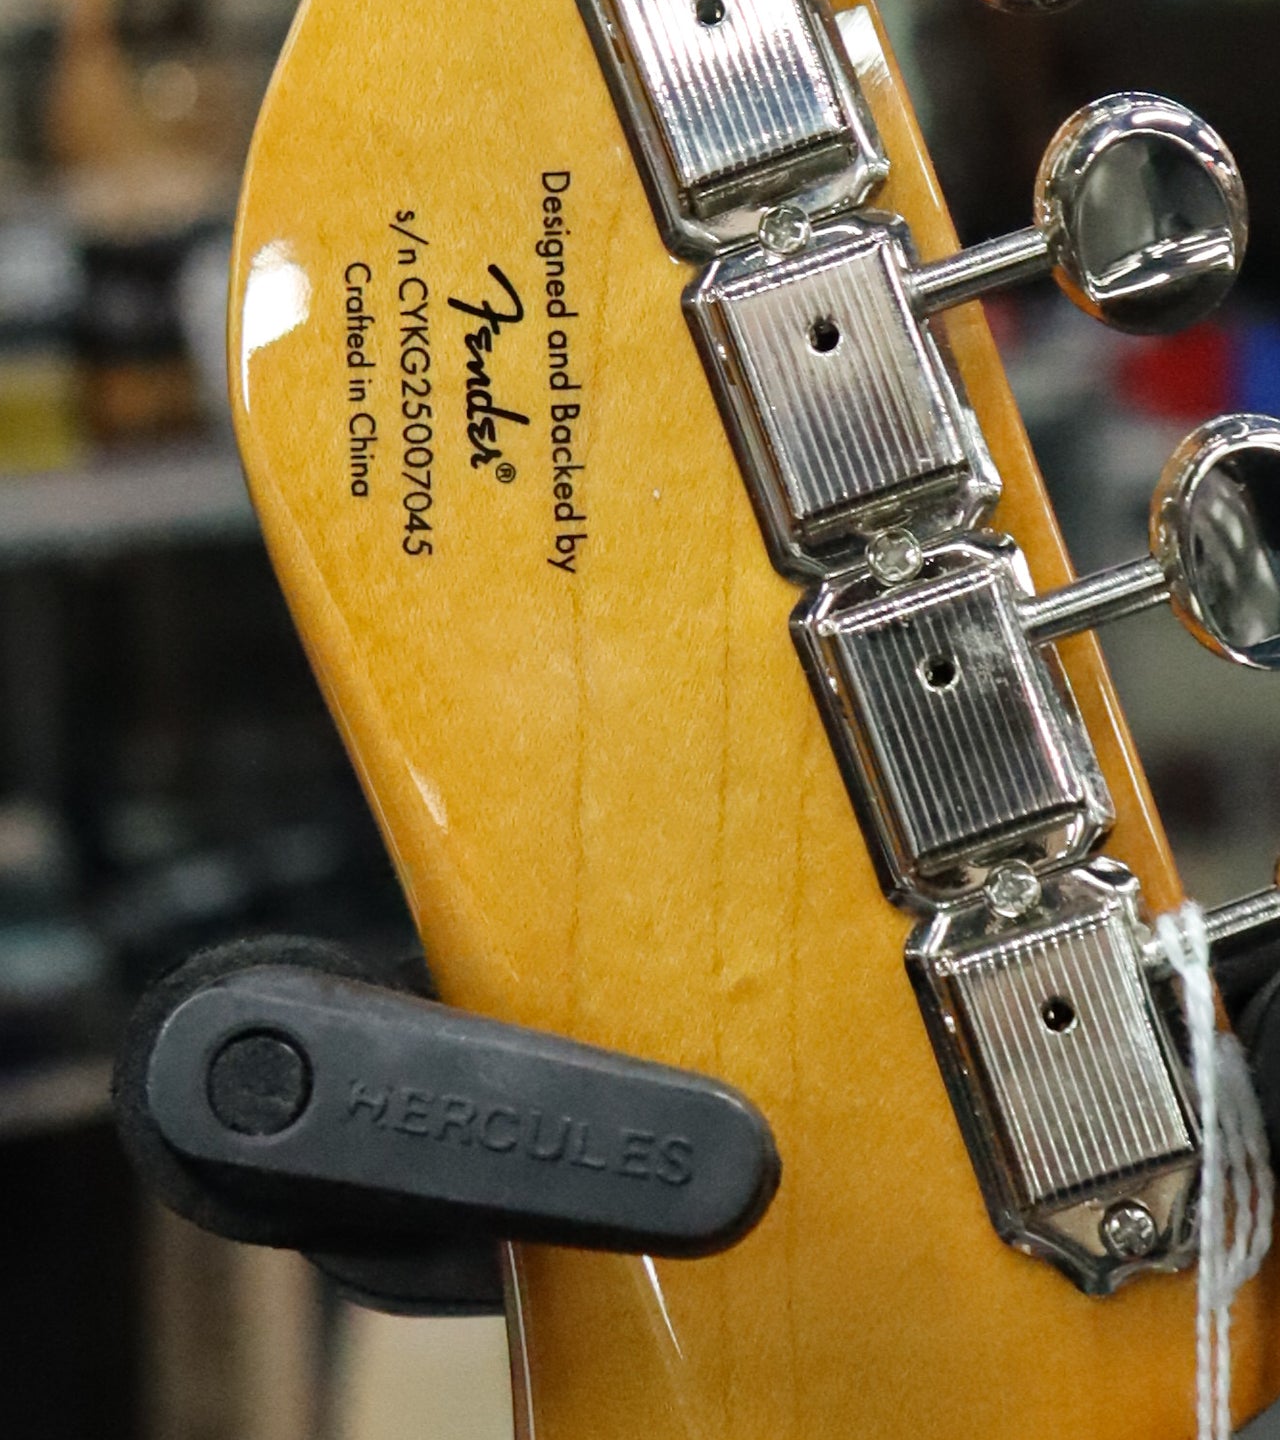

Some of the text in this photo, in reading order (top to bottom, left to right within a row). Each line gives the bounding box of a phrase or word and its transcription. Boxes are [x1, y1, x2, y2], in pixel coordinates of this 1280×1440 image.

[344, 262, 378, 498] Crafted in China
[388, 209, 434, 556] s/n CYKG25007045
[534, 170, 588, 574] Designed and Backed by
[347, 1078, 694, 1187] HERCULES
